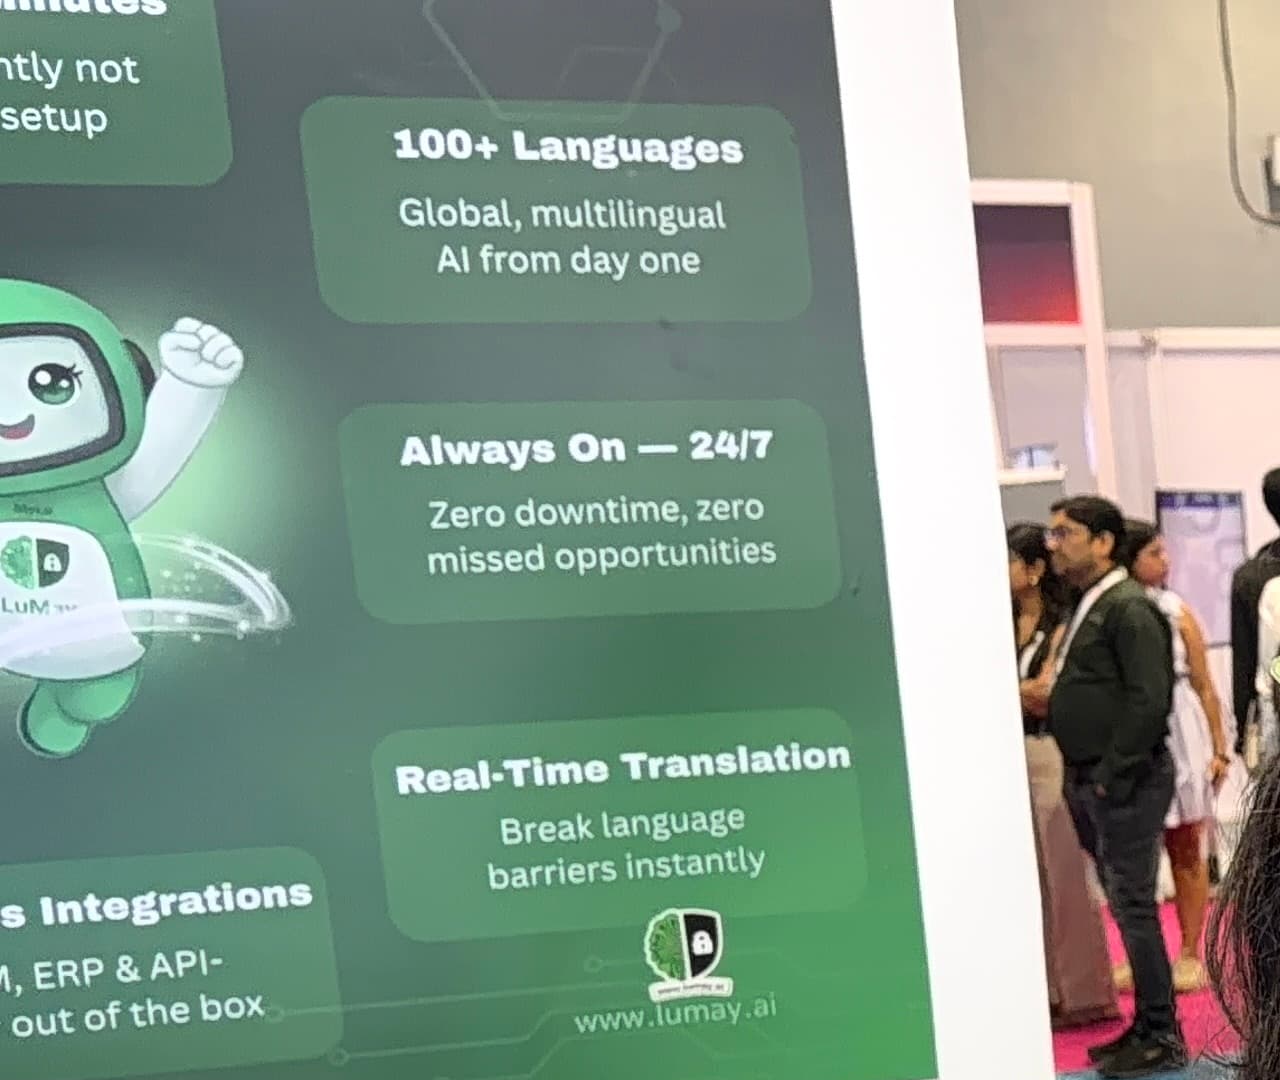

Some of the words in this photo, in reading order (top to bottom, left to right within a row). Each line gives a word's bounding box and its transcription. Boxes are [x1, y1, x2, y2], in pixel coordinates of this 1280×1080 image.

[75, 57, 140, 84] not
[0, 104, 107, 139] setup
[394, 128, 498, 160] 100+
[514, 131, 744, 169] Languages
[399, 197, 522, 232] Global,
[531, 199, 726, 235] multilingual
[437, 245, 470, 275] AI
[481, 247, 561, 276] from
[570, 247, 630, 281] day
[640, 249, 701, 276] one
[401, 434, 555, 471] Always
[568, 433, 625, 465] On
[690, 429, 773, 460] 24/7
[429, 500, 505, 530] Zero
[514, 496, 687, 527] downtime,
[696, 496, 765, 521] zero
[428, 544, 546, 576] missed
[555, 538, 777, 578] opportunities
[397, 758, 609, 795] Real-Time
[620, 742, 851, 780] Translation
[501, 813, 593, 846] Break
[603, 806, 745, 846] language
[488, 858, 617, 892] barriers
[627, 847, 766, 883] instantly
[40, 882, 313, 927] Integrations
[34, 957, 104, 990] ERP
[116, 954, 141, 982] &
[151, 949, 223, 981] API-
[12, 1008, 75, 1038] out
[84, 1000, 121, 1031] of
[129, 998, 190, 1028] the
[200, 993, 265, 1021] box
[574, 991, 777, 1033] www.lumay.ai
